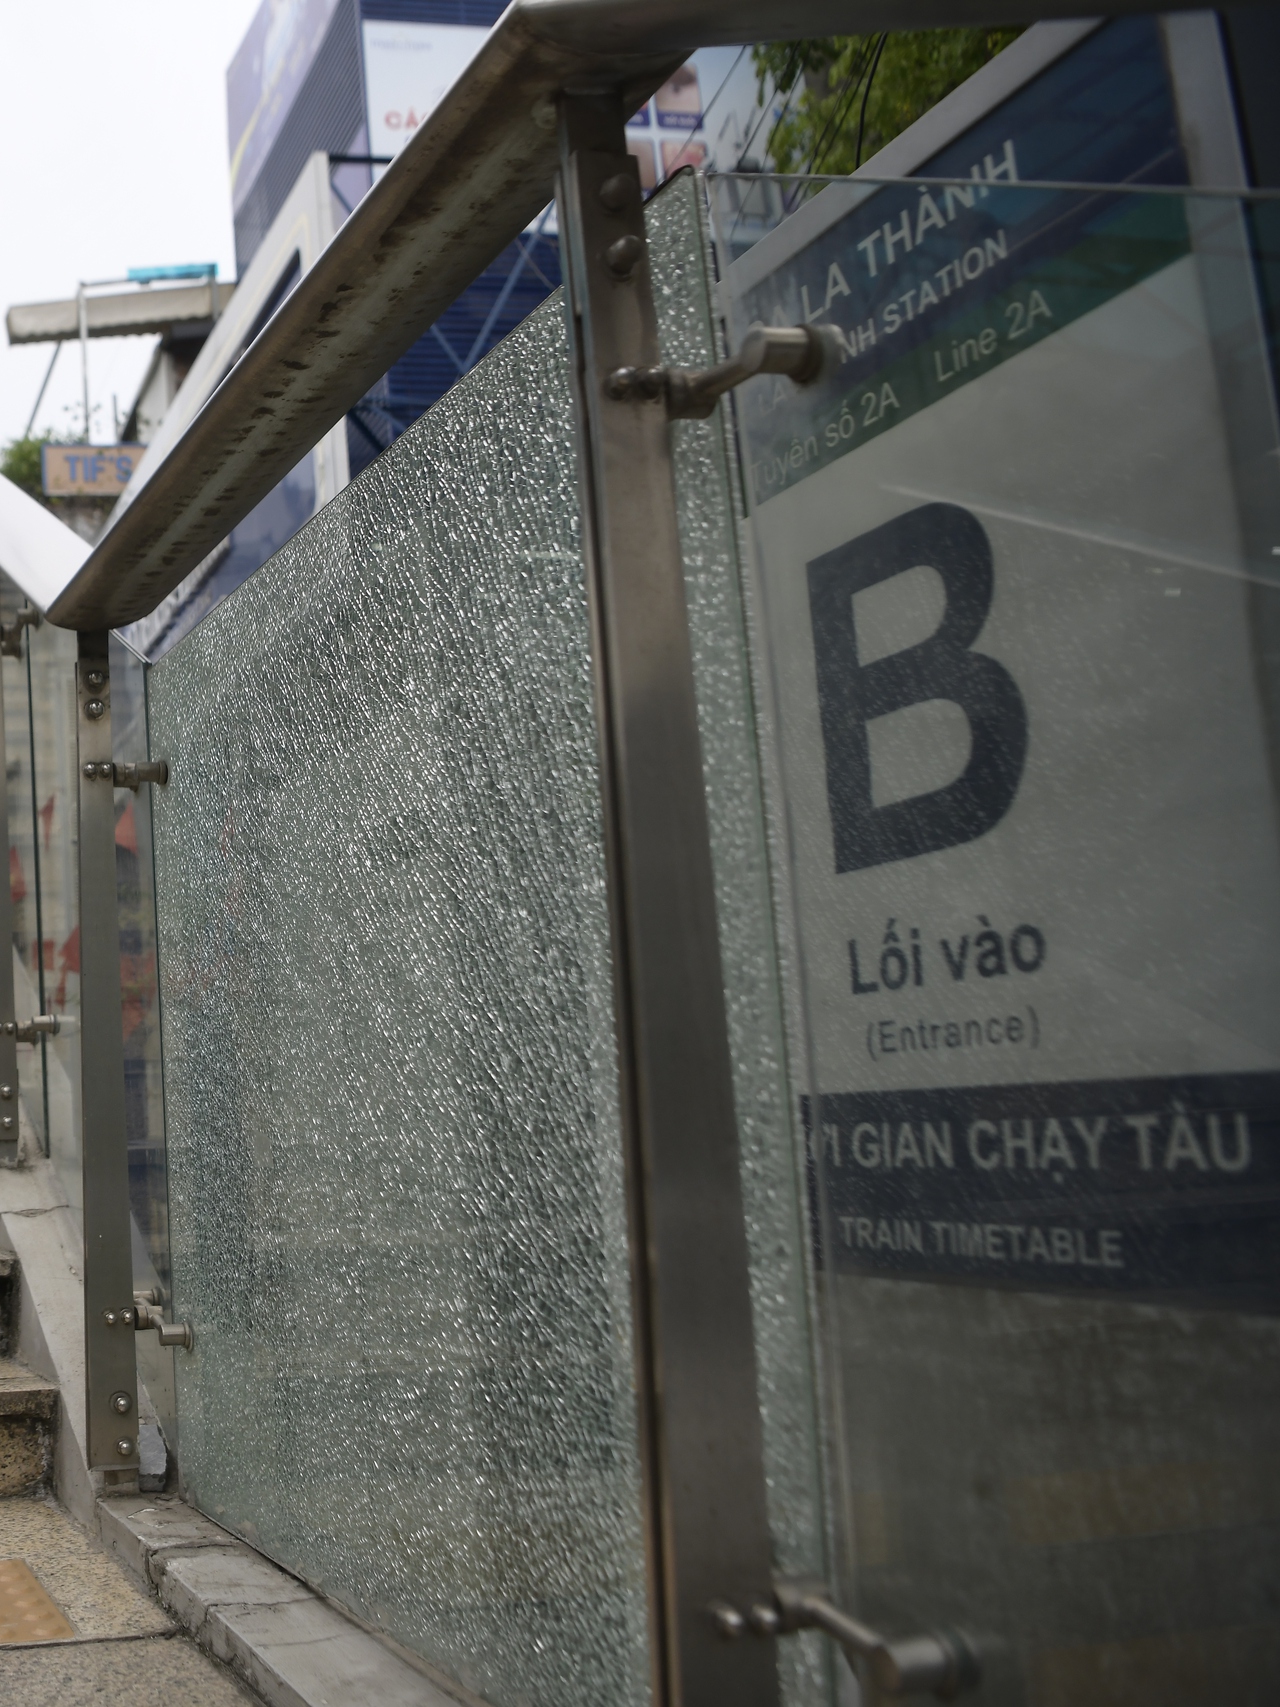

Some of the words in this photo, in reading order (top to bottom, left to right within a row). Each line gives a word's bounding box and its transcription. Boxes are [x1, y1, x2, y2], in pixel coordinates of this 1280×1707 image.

[801, 262, 851, 323] LA
[857, 138, 1019, 278] THÀNH
[882, 229, 1008, 333] STATION
[825, 399, 856, 447] số
[860, 382, 900, 427] 2A
[934, 328, 998, 382] Line
[1005, 289, 1053, 340] 2A
[806, 502, 1029, 874] B
[847, 917, 924, 995] Lối
[941, 914, 1047, 982] vào
[865, 1005, 1041, 1060] (Entrance)
[851, 1121, 955, 1169] GIAN
[968, 1115, 1110, 1184] CHẠY
[1123, 1100, 1253, 1172] TÀU
[838, 1215, 924, 1254] TRAIN
[927, 1219, 1126, 1268] TIMETABLE
